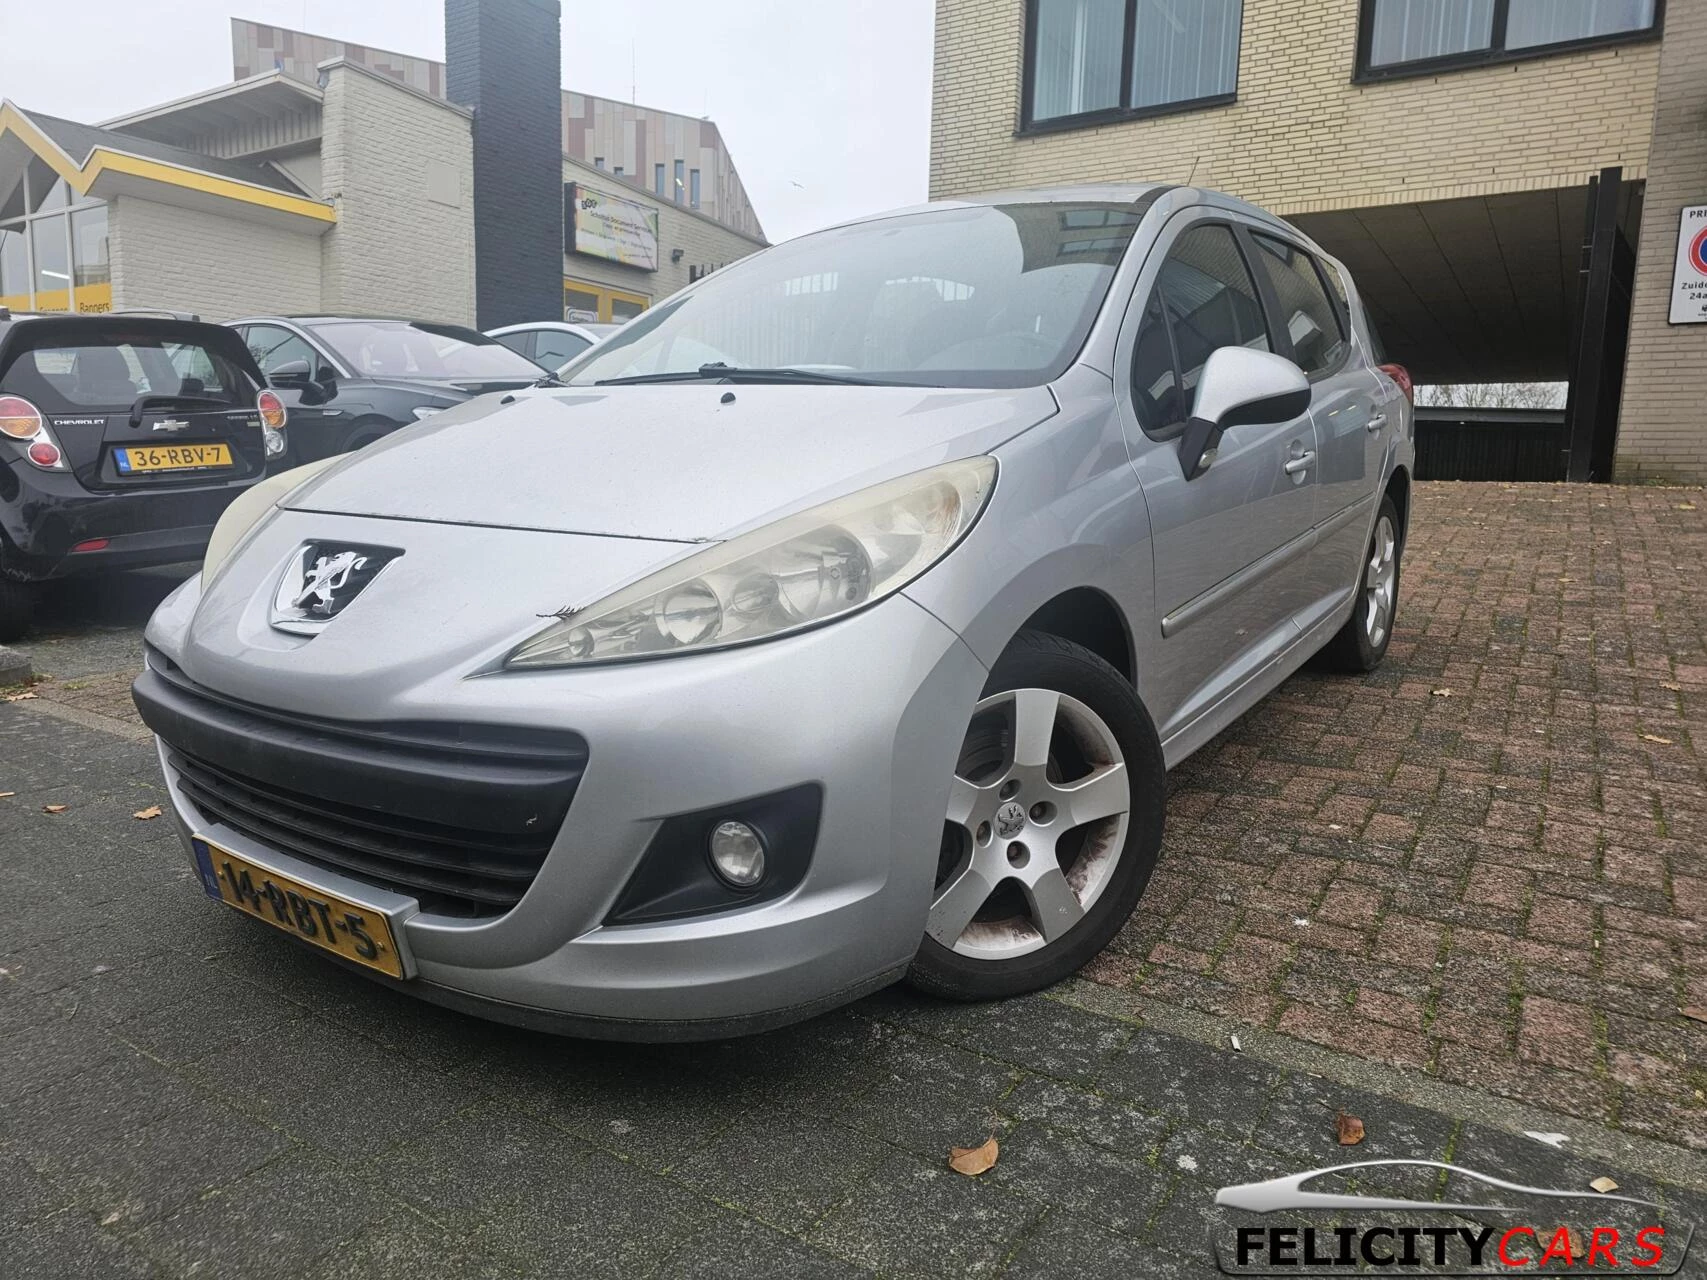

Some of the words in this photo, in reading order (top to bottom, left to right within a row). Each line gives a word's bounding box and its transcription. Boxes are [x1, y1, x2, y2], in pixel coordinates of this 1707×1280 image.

[80, 302, 110, 314] Banners
[134, 447, 220, 467] 36-RBV-7
[222, 860, 379, 961] 14-RBT-5
